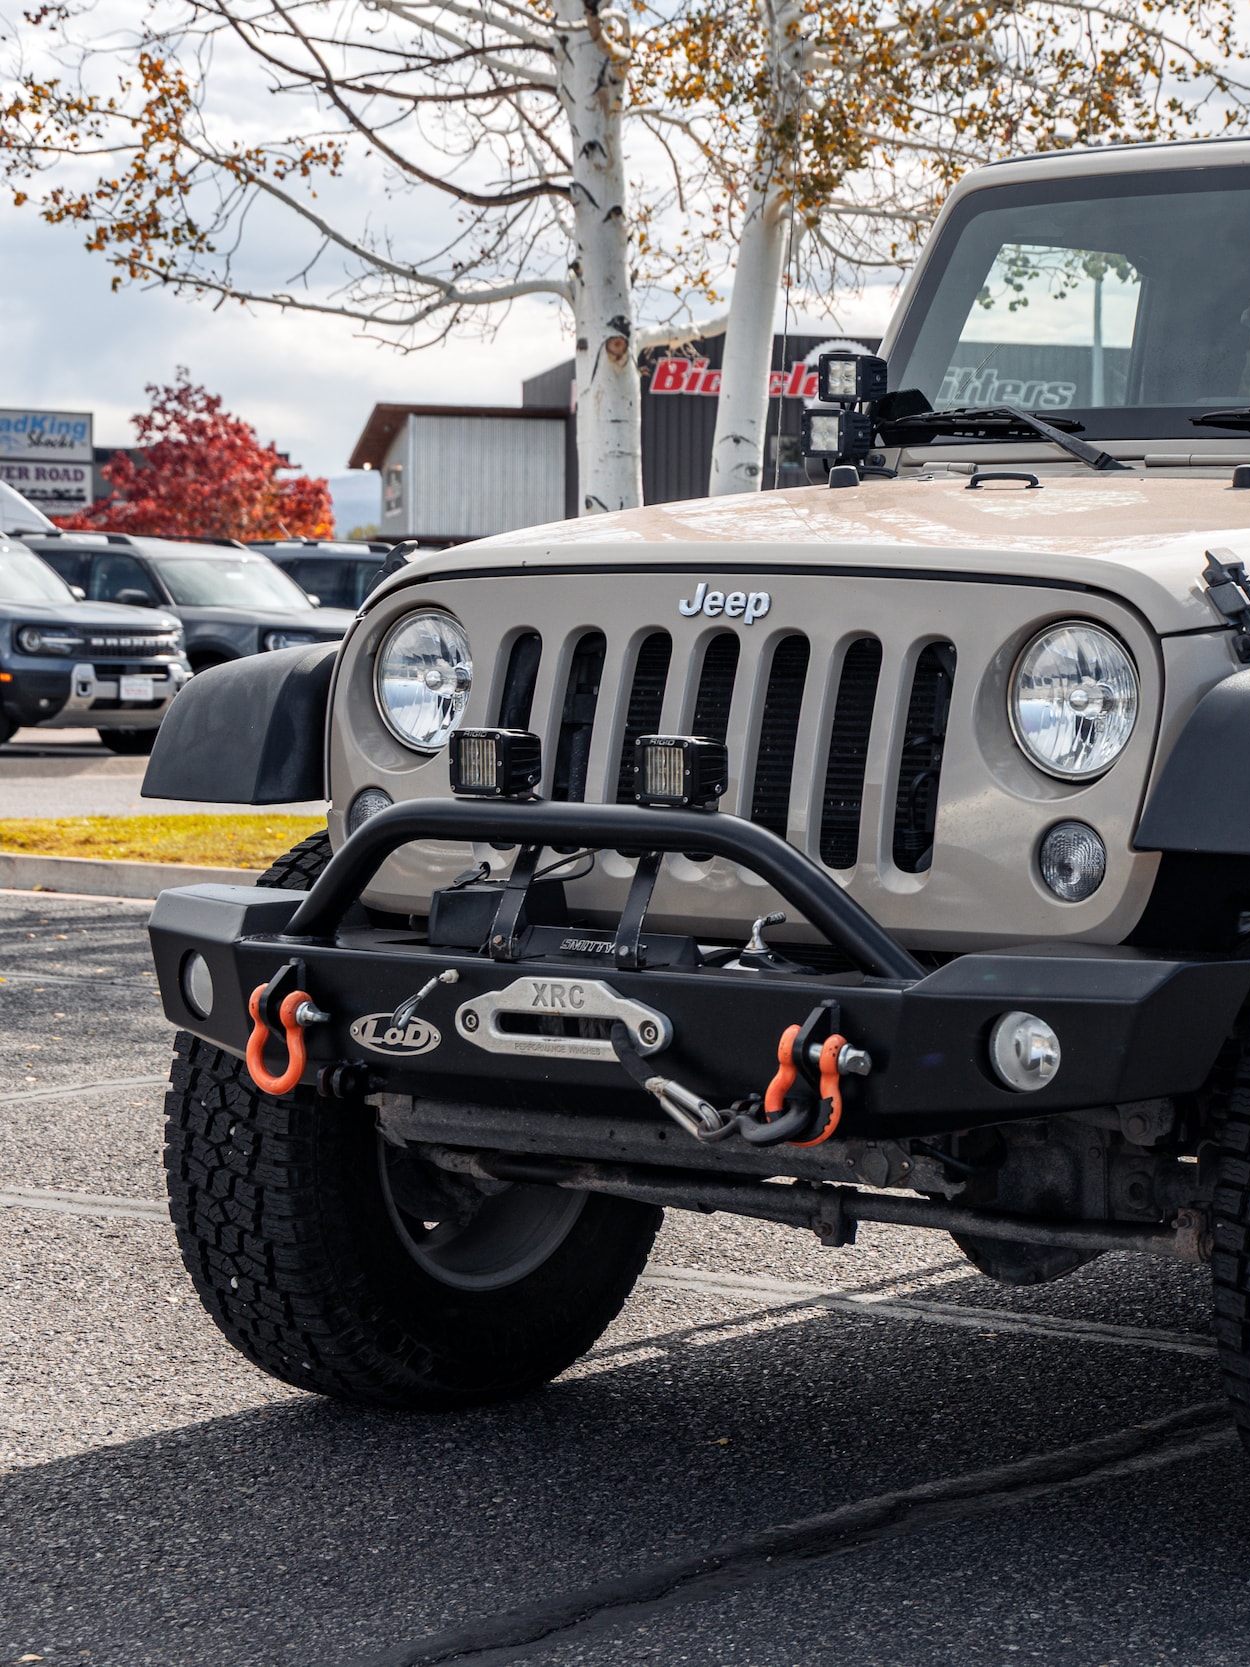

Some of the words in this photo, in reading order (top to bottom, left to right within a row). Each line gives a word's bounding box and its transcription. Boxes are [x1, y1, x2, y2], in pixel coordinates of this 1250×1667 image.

[650, 357, 820, 398] Biccle
[35, 466, 85, 482] ROAD
[678, 582, 771, 625] Jeep
[463, 730, 488, 738] RIGID
[649, 738, 675, 746] RIGID
[560, 939, 616, 954] SMITTY
[531, 983, 585, 1009] XRC
[514, 1042, 567, 1054] PERFORMANCE
[568, 1044, 601, 1056] WINCHES
